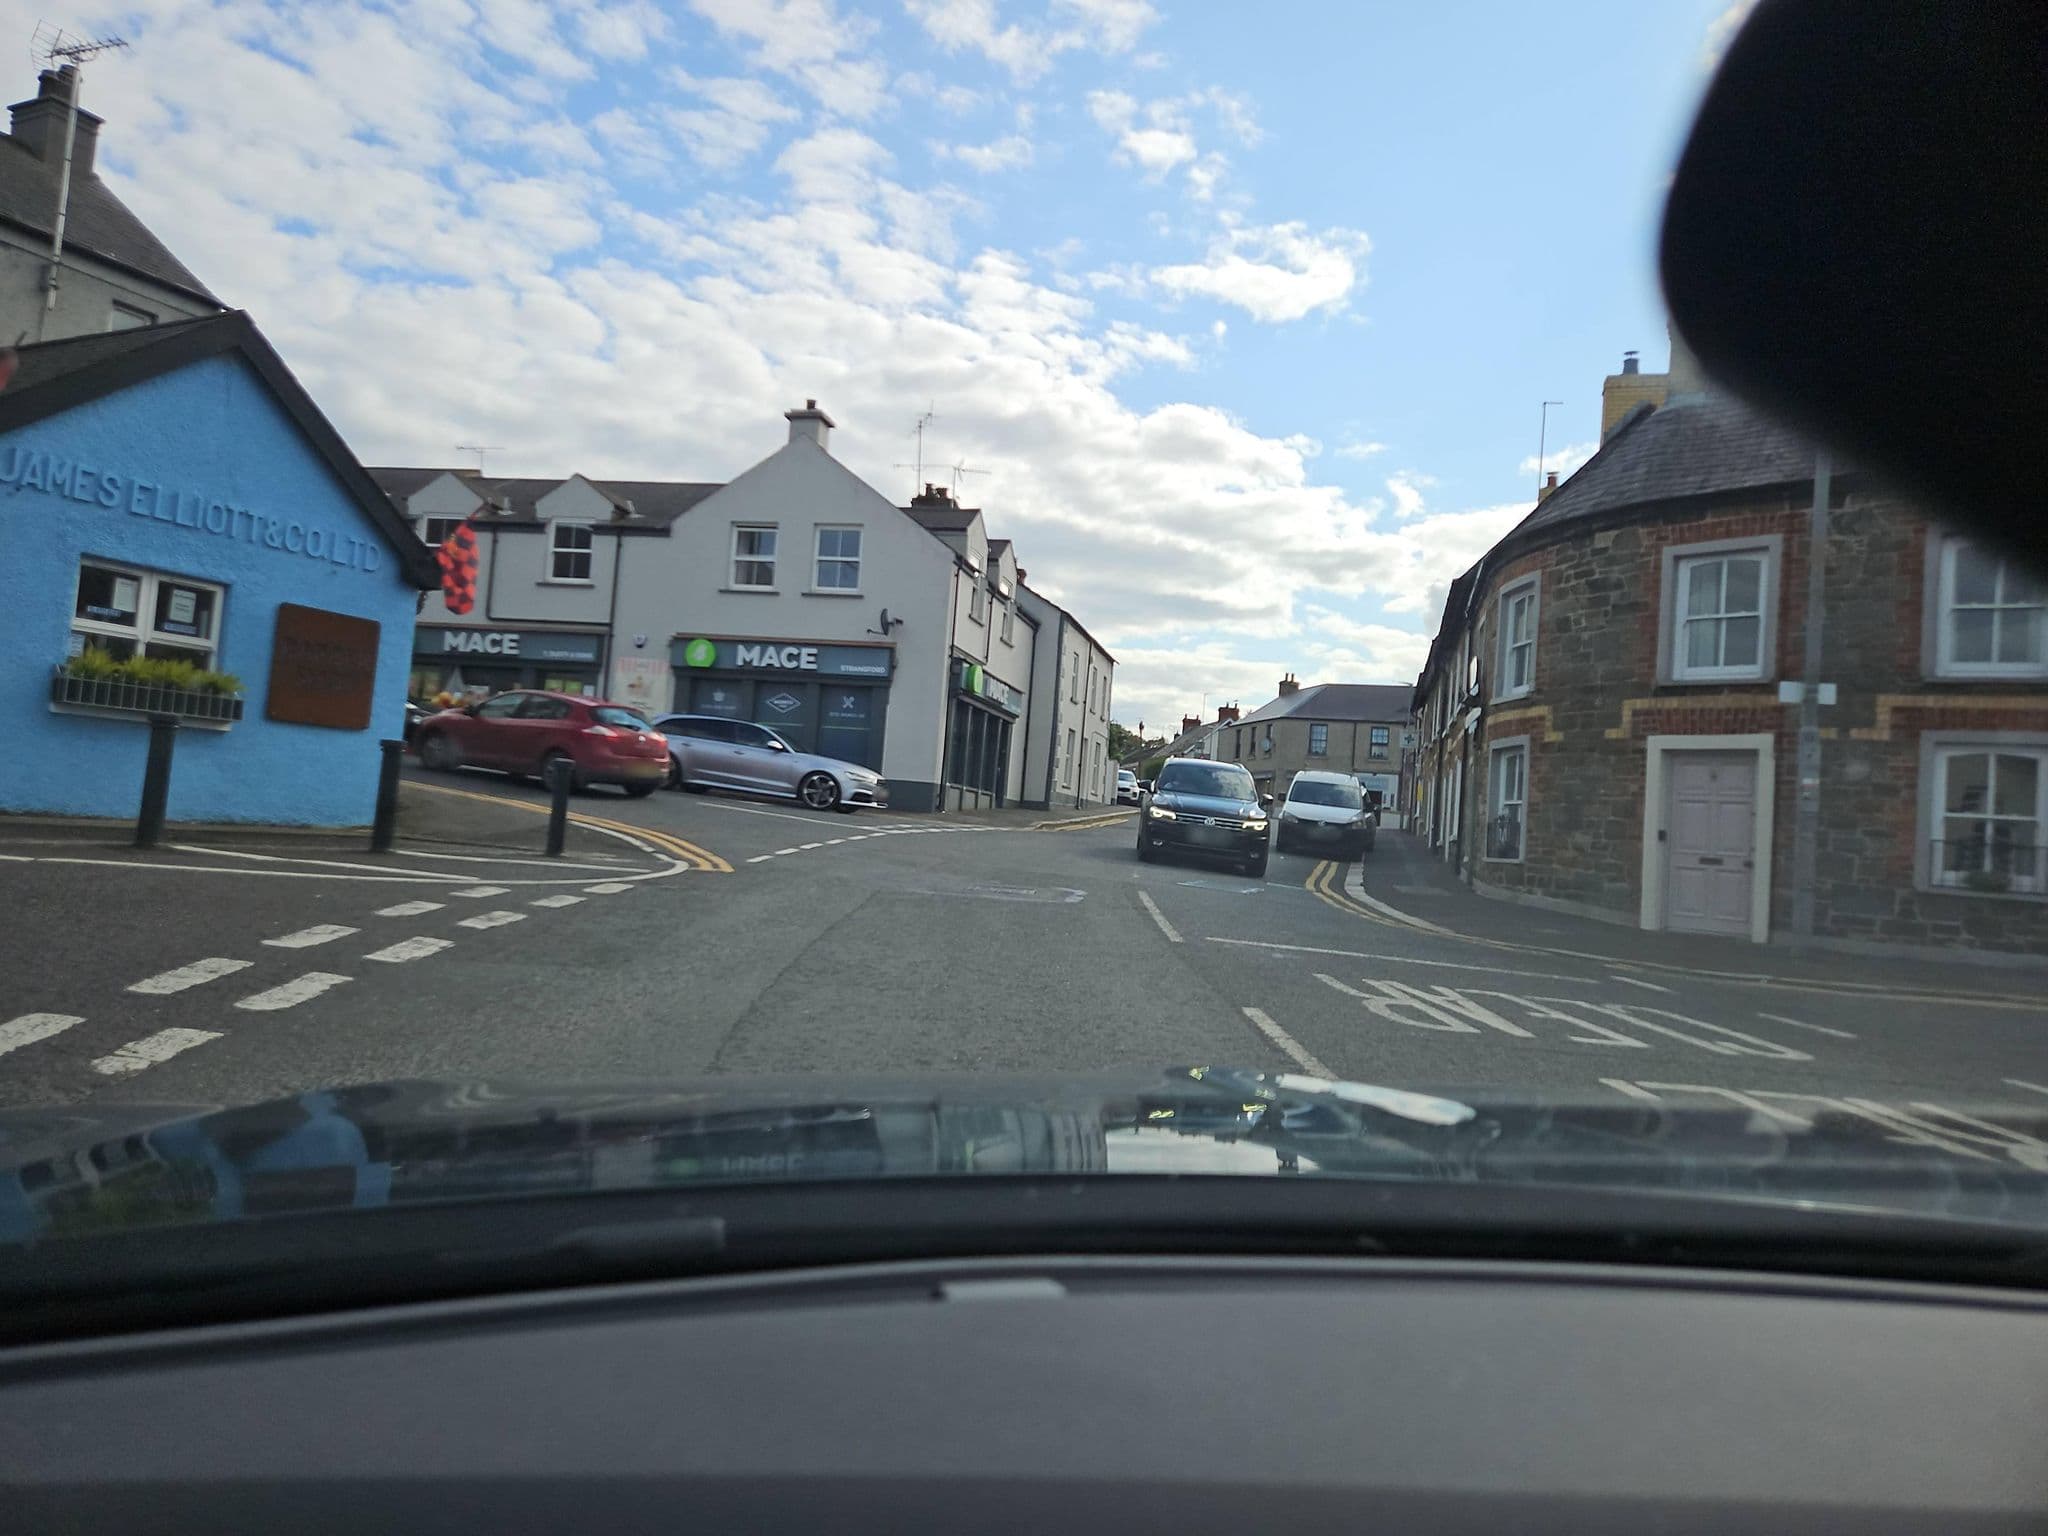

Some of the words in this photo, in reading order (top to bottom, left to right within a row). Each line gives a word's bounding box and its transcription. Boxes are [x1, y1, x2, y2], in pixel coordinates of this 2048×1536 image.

[0, 447, 121, 509] JAMES
[444, 631, 521, 655] MACE
[736, 644, 818, 670] MACE
[1312, 973, 1816, 1060] CLEAR
[1599, 1077, 2048, 1173] KE
